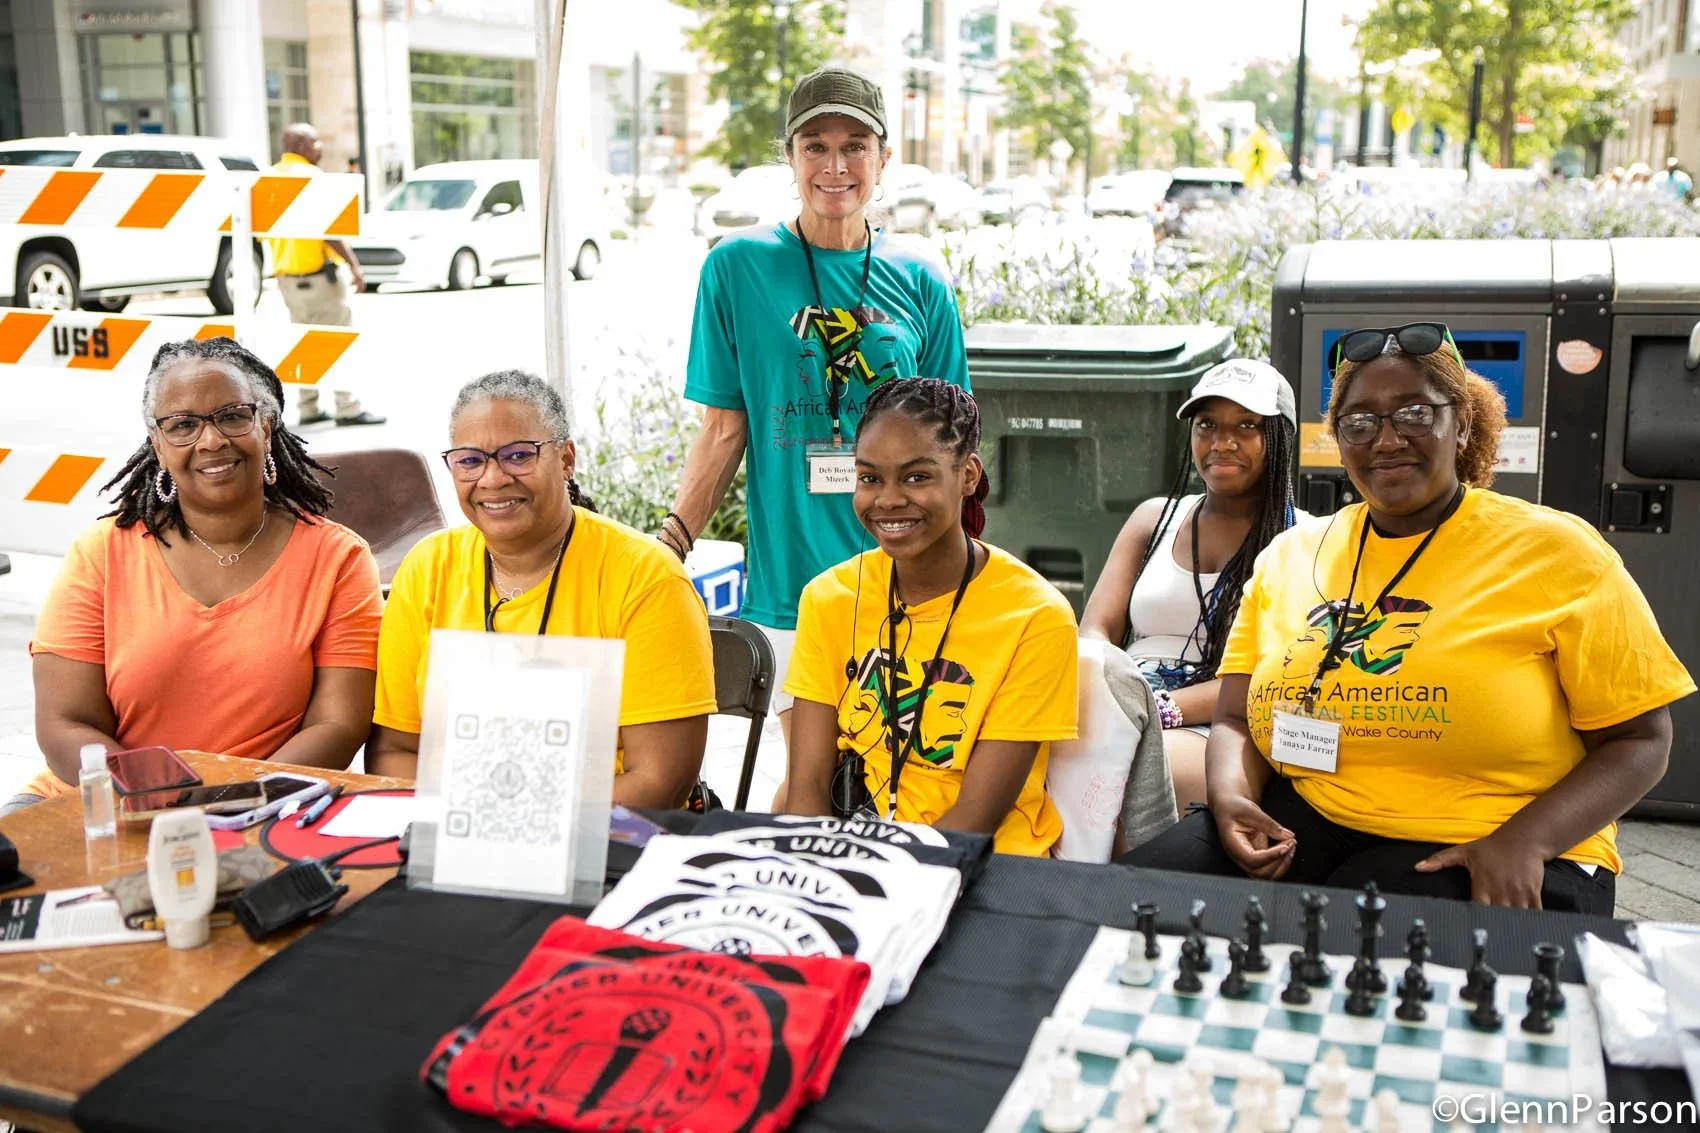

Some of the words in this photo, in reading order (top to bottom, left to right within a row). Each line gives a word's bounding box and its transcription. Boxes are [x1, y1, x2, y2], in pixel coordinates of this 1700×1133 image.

[53, 325, 109, 358] USS
[818, 466, 832, 474] Deb
[825, 475, 850, 483] Mizerk
[1254, 680, 1321, 703] African
[1328, 681, 1448, 703] American
[1352, 705, 1452, 724] FESTIVAL
[1278, 727, 1299, 738] Stage
[1301, 730, 1337, 745] Manager
[1342, 727, 1382, 738] Wake
[1387, 727, 1443, 742] County
[1307, 743, 1335, 755] Farrar
[789, 836, 870, 859] UNIV
[755, 869, 833, 896] UNIV
